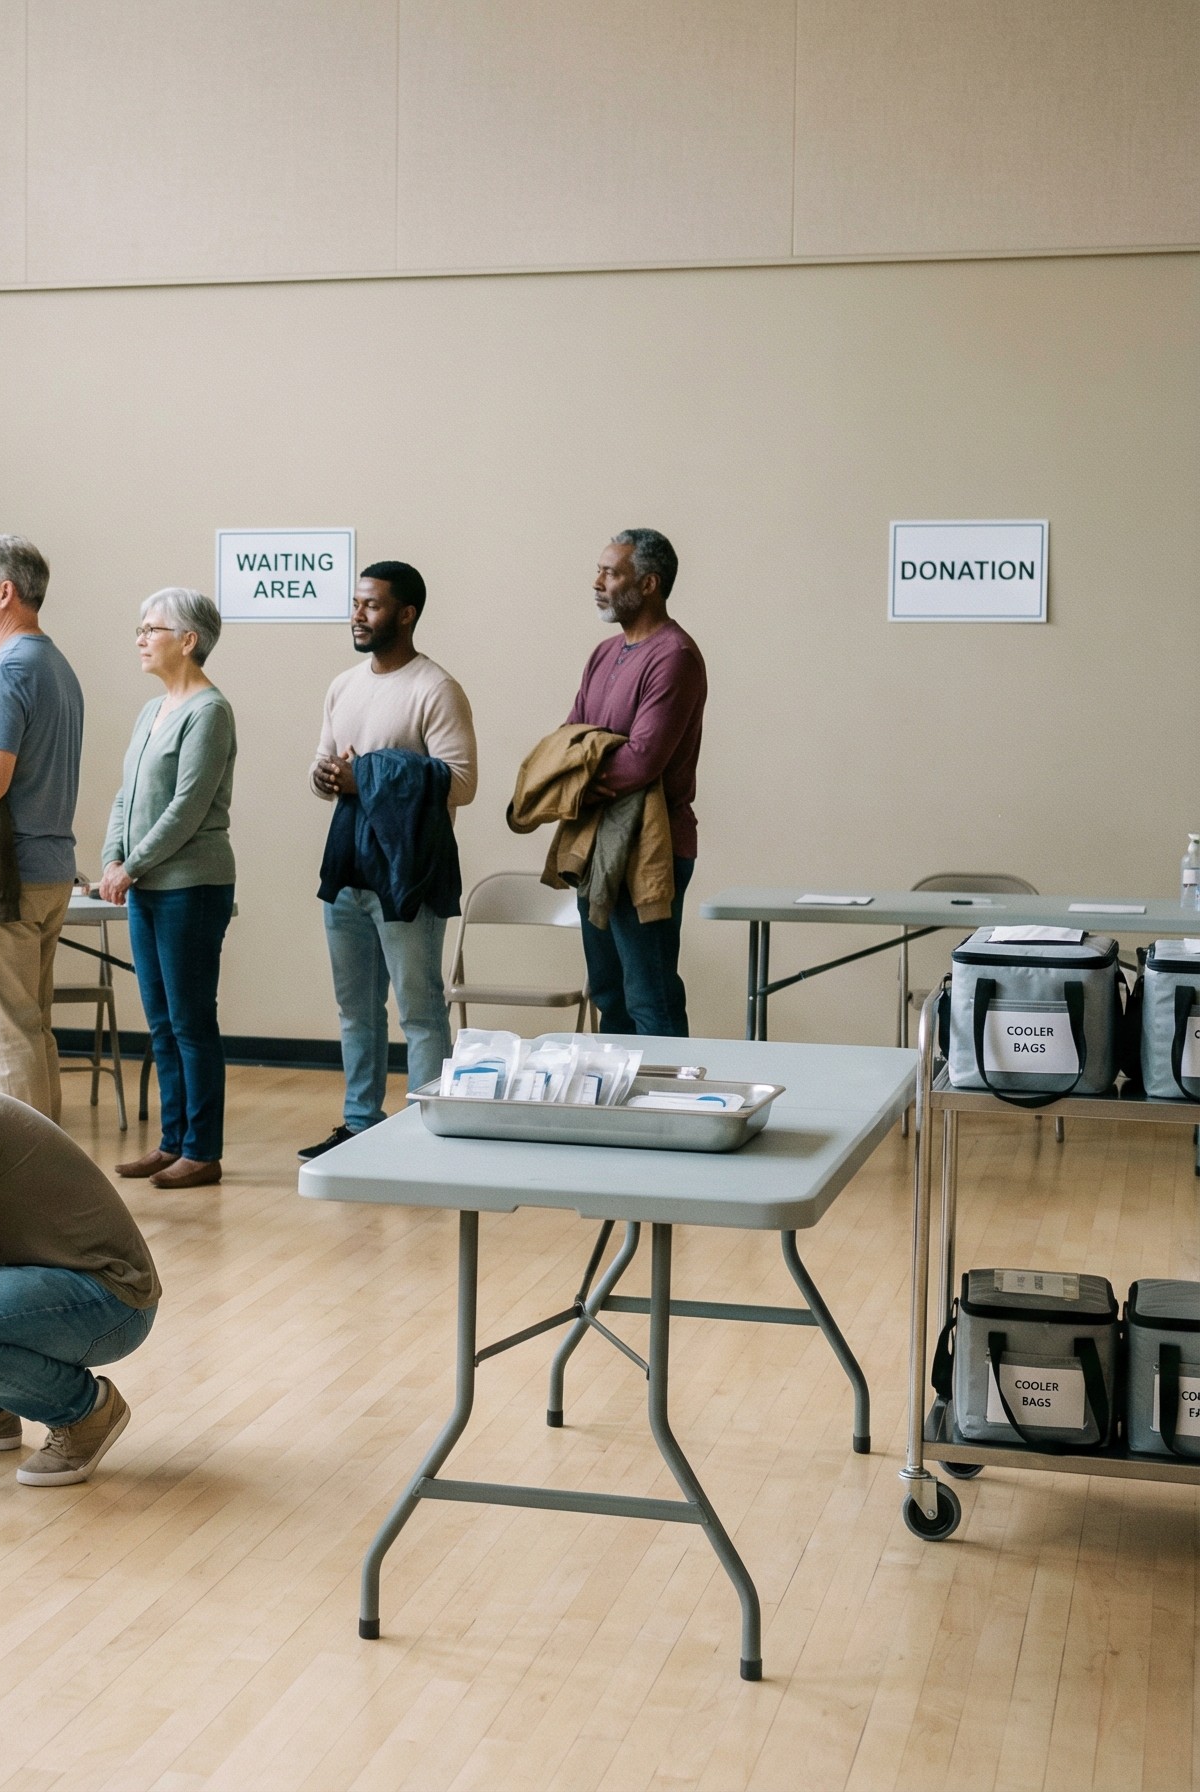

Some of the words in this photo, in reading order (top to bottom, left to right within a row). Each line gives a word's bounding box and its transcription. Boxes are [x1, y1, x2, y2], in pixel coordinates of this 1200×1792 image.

[236, 552, 334, 572] WAITING
[900, 560, 1035, 581] DONATION
[253, 580, 317, 599] AREA
[1006, 1025, 1054, 1038] COOLER
[1013, 1042, 1046, 1054] BAGS
[1014, 1379, 1060, 1393] COOLER
[1021, 1396, 1052, 1408] BAGS
